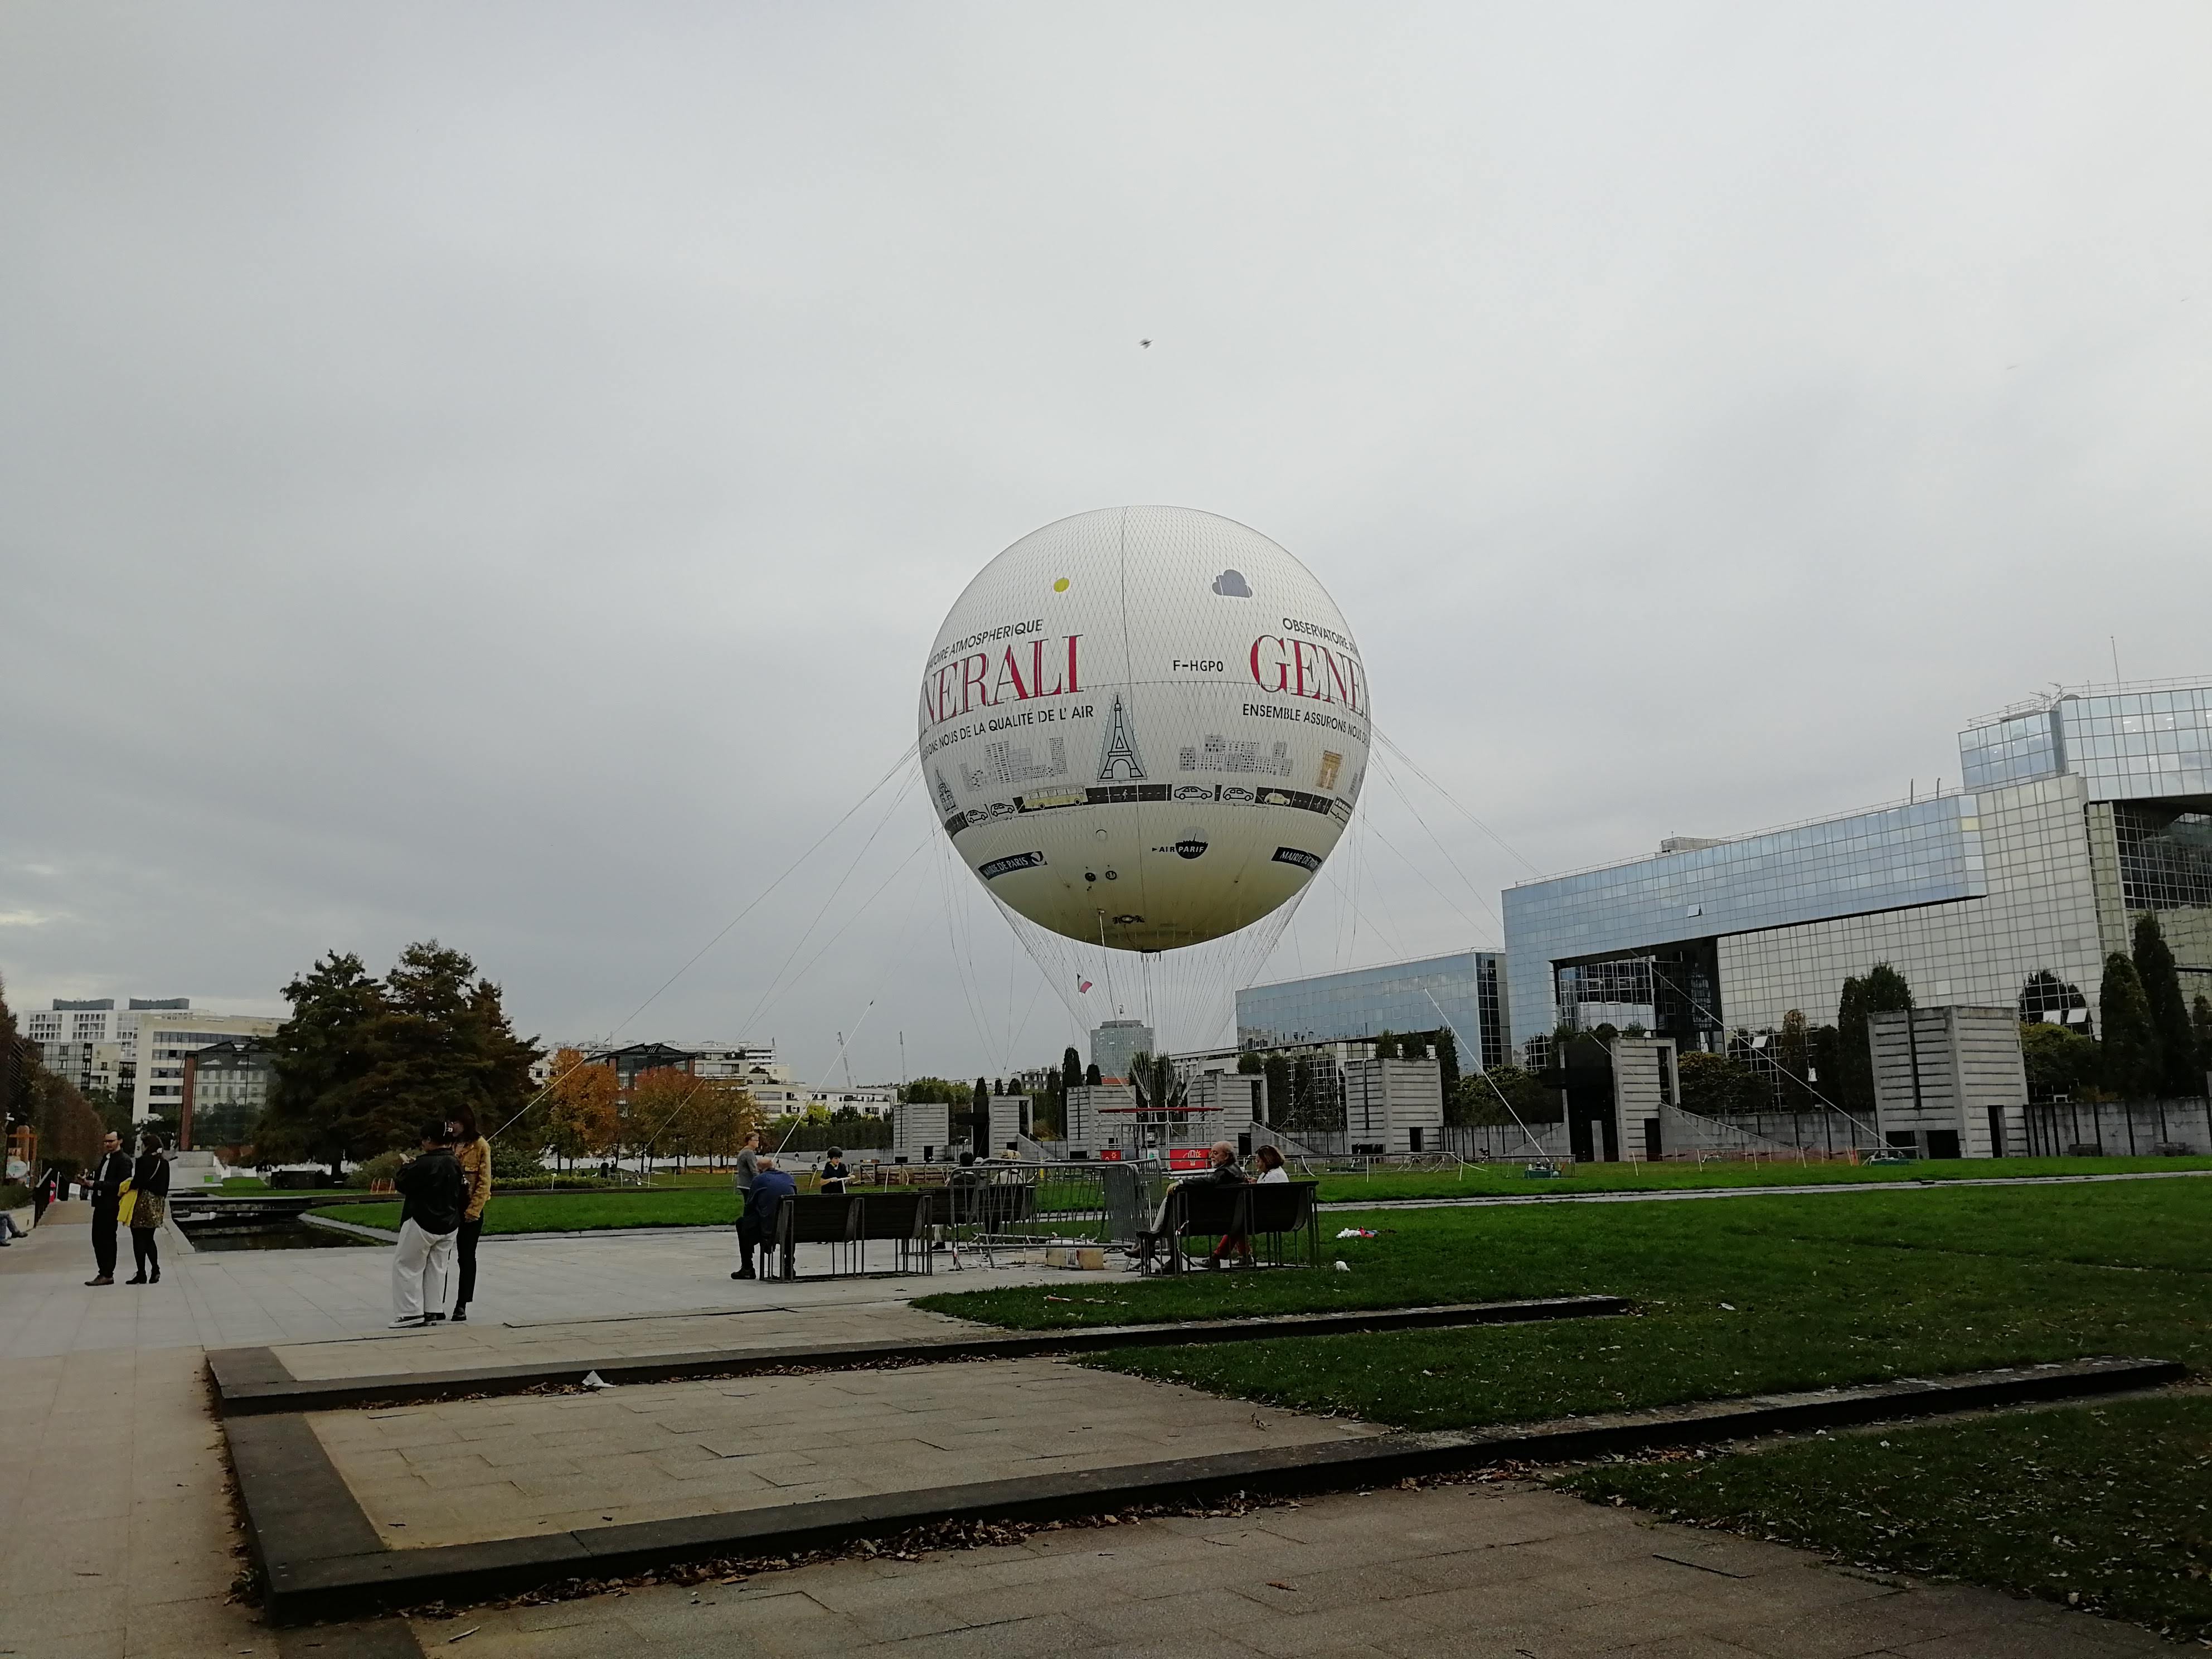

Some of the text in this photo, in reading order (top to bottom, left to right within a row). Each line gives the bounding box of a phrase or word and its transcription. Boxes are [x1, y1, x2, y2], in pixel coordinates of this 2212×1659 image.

[949, 619, 1043, 657] ATMOSPHERIQUE
[1283, 618, 1349, 650] OBSERVATOIRE
[939, 730, 958, 749] NOUS
[960, 725, 972, 740] DE
[974, 722, 986, 736] LA
[988, 709, 1034, 731] QUALITÉ
[1038, 709, 1055, 723] DE
[1243, 704, 1301, 721] ENSEMBLE
[1303, 711, 1347, 733] ASSURONS
[997, 861, 1008, 871] DE
[1006, 857, 1029, 869] PARIS
[1279, 851, 1305, 863] MAIRIE
